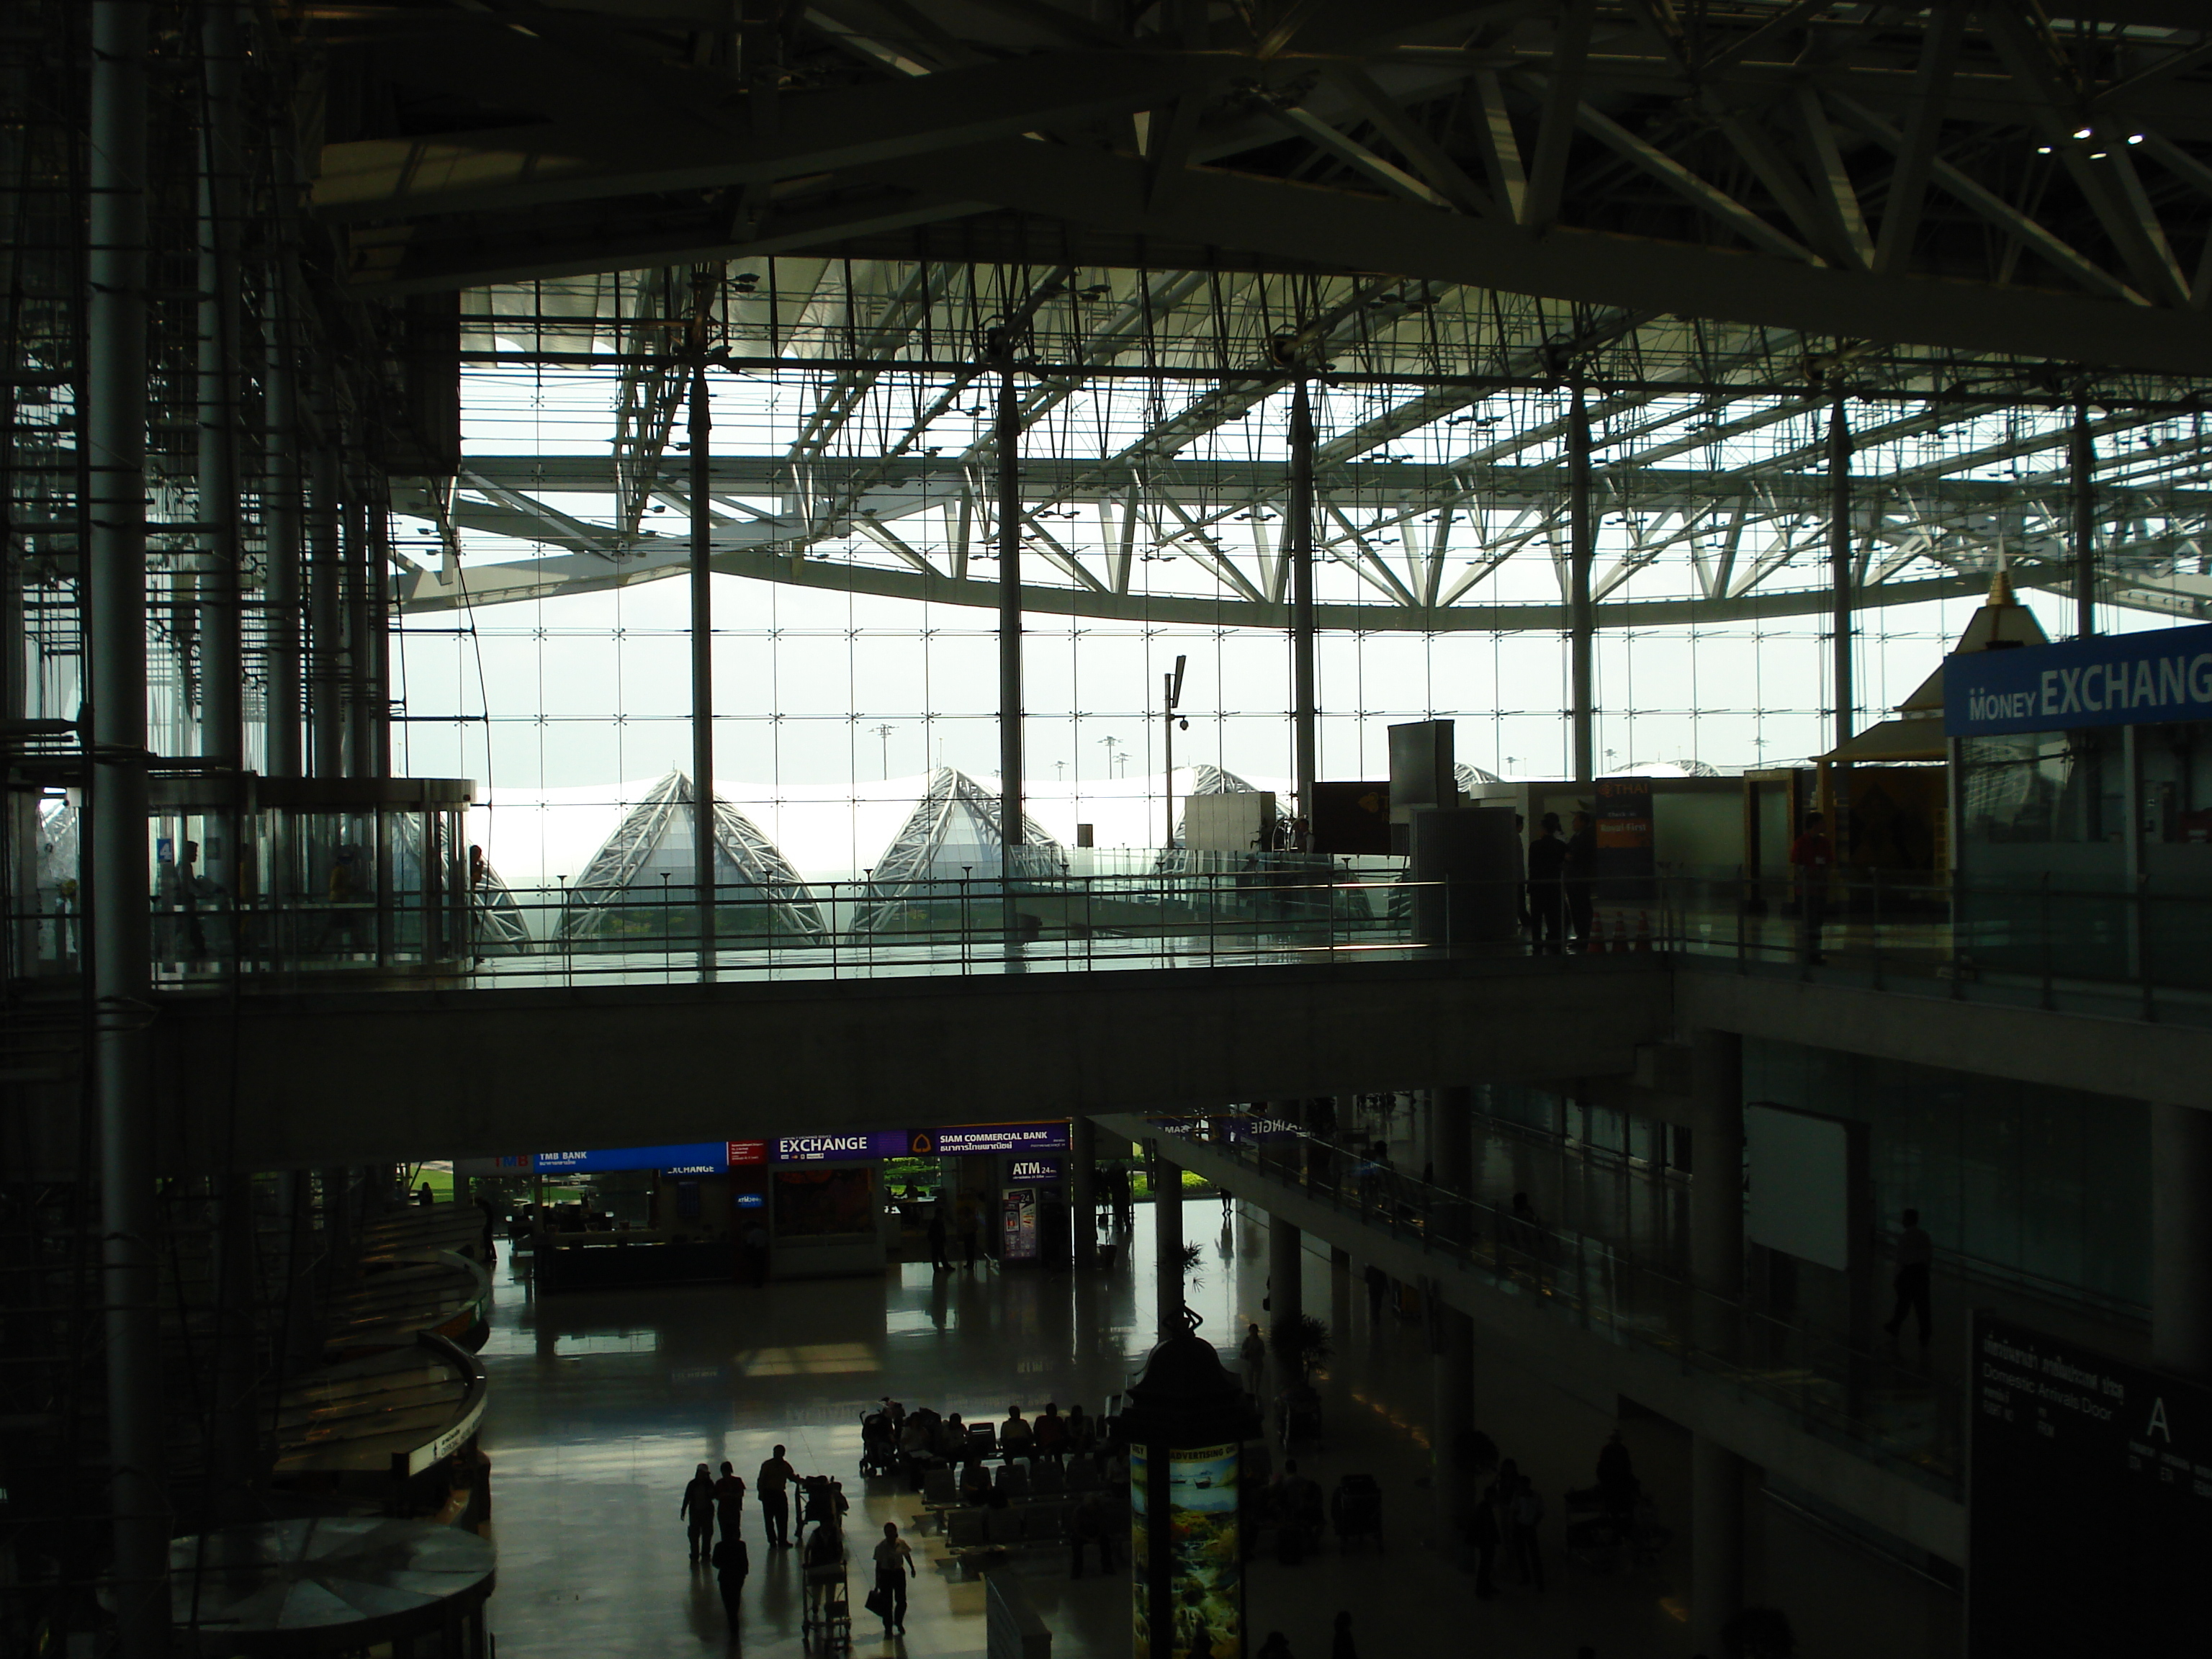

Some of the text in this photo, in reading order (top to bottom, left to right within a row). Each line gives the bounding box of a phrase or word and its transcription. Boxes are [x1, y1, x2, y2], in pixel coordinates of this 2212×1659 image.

[1969, 687, 2037, 721] MONEY
[1614, 783, 1648, 795] THAI
[160, 842, 172, 860] 4
[779, 1136, 868, 1153] EXCHANGE
[940, 1131, 1048, 1143] SIAM COMMERCIAL BANK
[539, 1151, 587, 1161] TMB BANK
[1012, 1161, 1040, 1175] ATM
[1983, 1363, 2036, 1393] Domestic
[2038, 1382, 2080, 1409] Arrivals
[2082, 1397, 2113, 1421] Door
[2146, 1396, 2171, 1444] A
[1169, 1448, 1223, 1460] ADVERTISING
